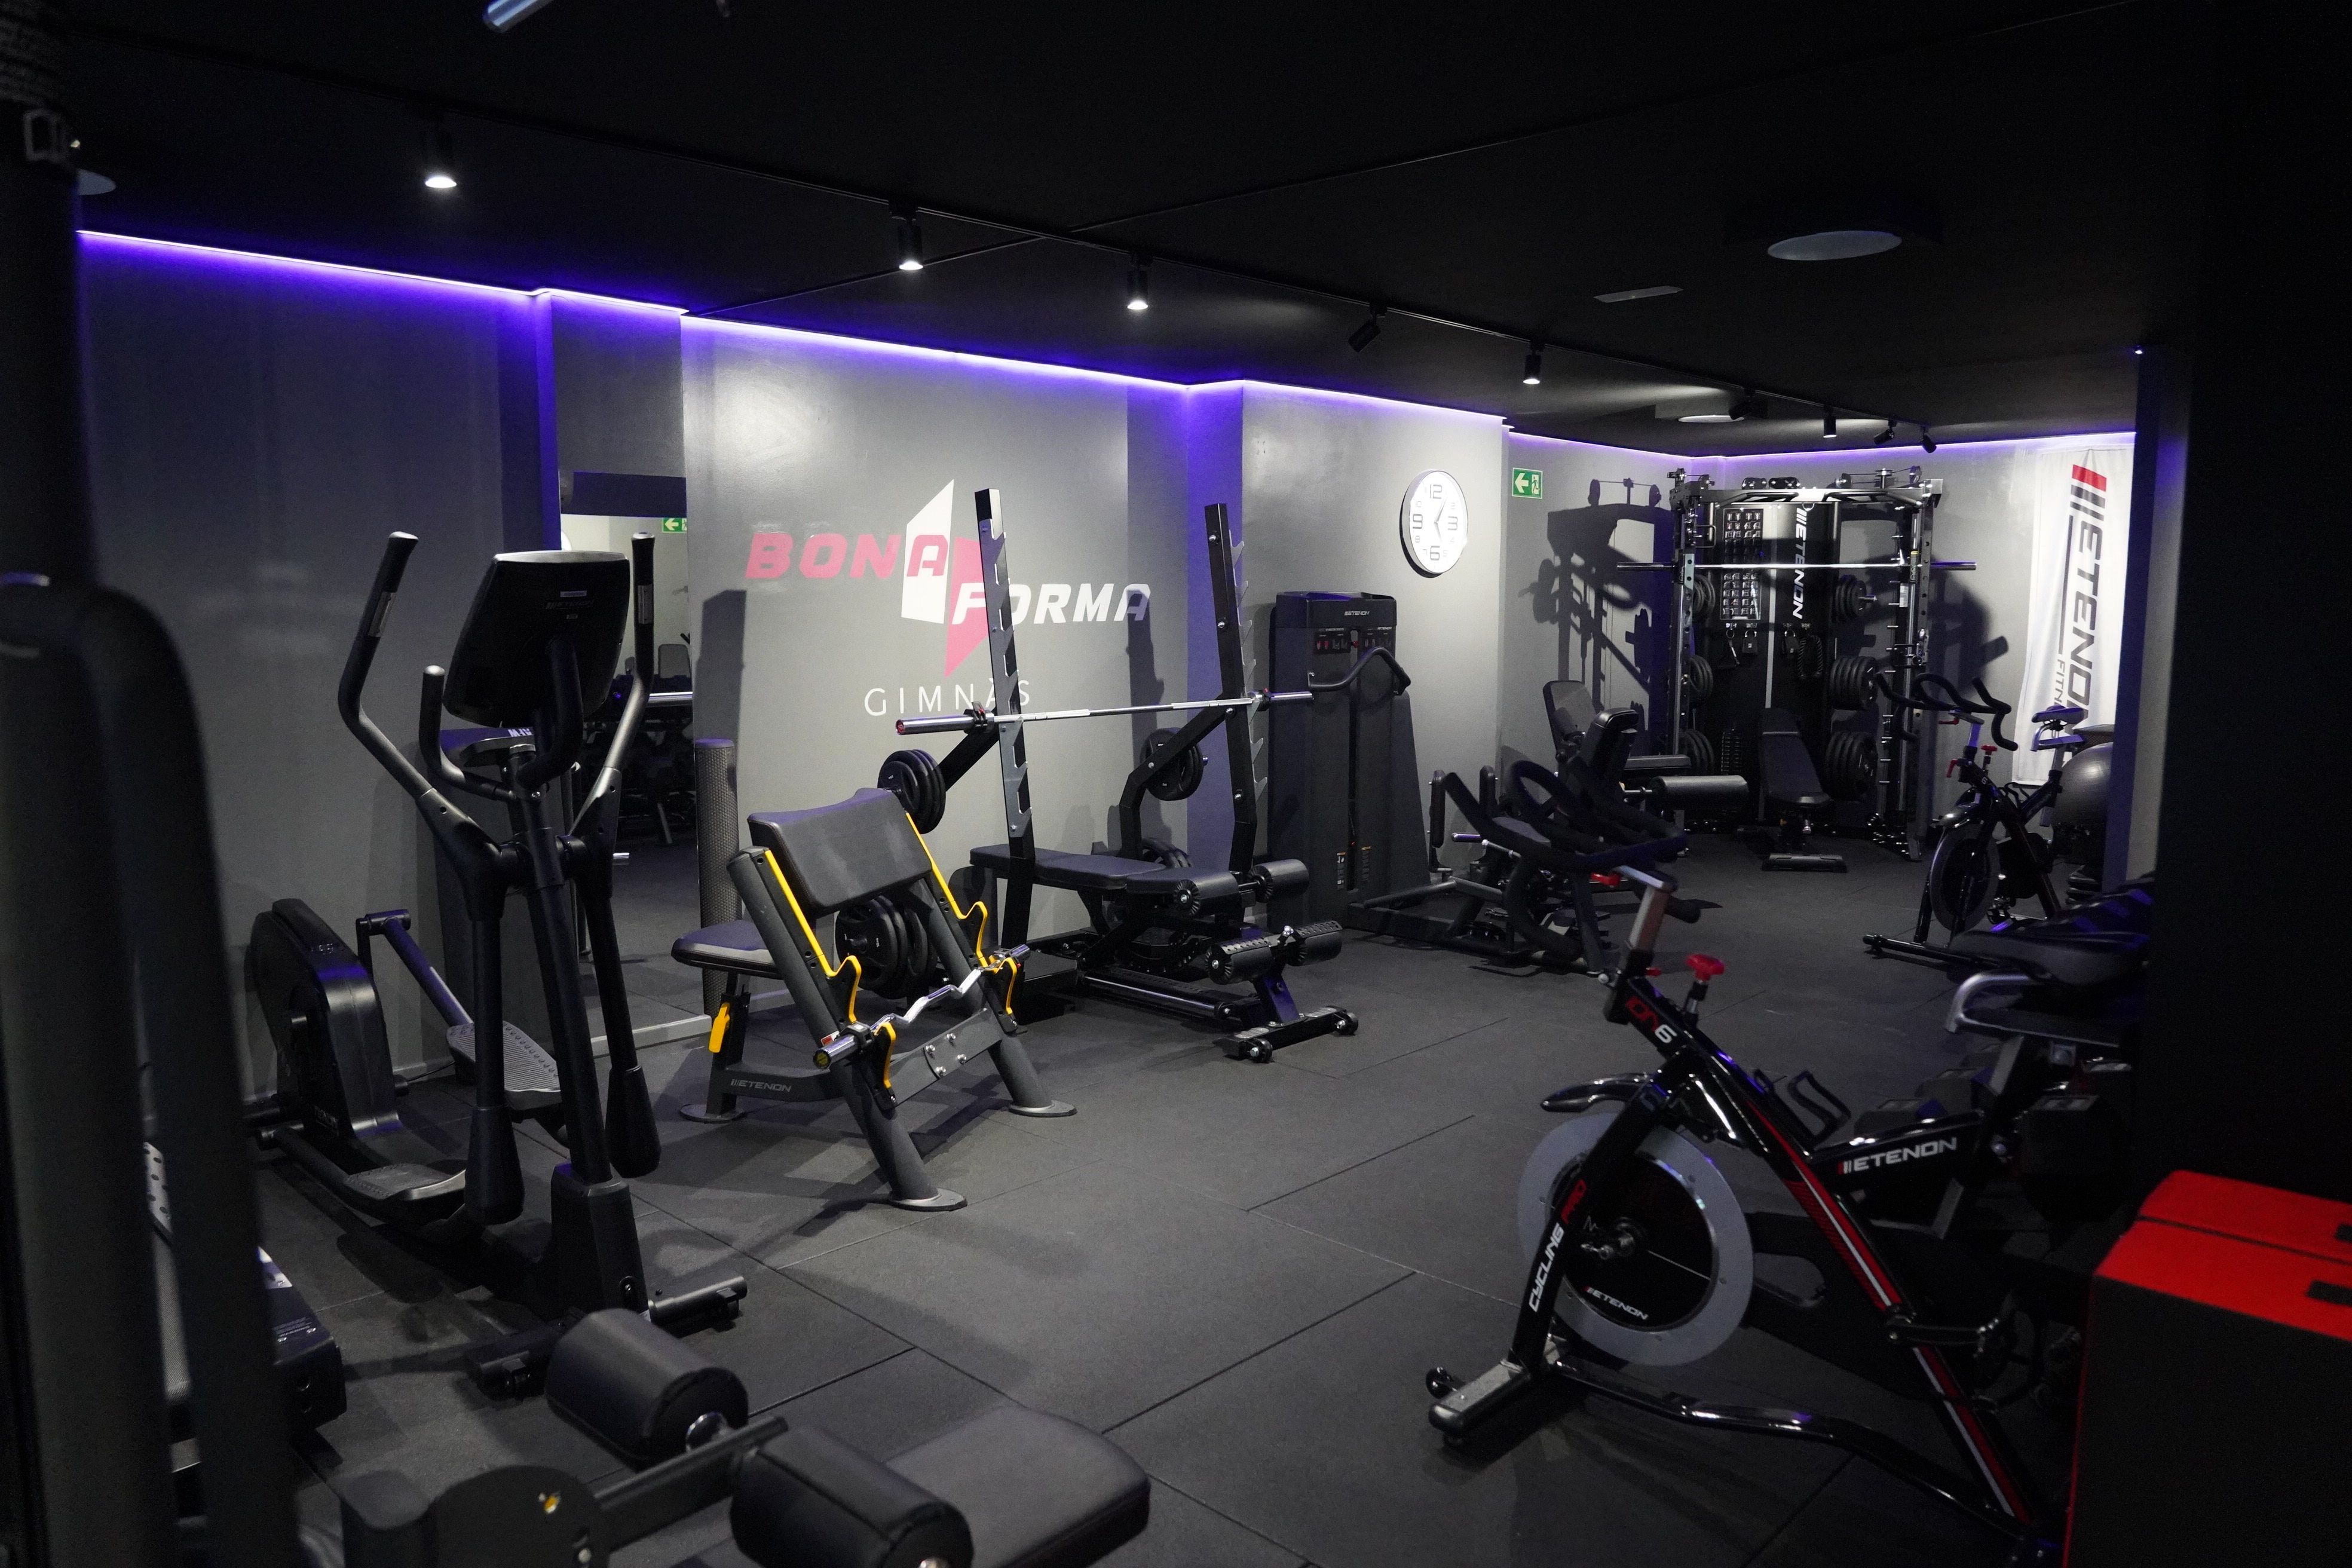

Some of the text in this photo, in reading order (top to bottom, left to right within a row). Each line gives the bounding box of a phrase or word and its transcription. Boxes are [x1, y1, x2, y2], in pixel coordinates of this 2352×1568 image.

[1430, 484, 1443, 499] 12
[1412, 513, 1423, 529] 9
[1448, 516, 1458, 531] 3
[745, 533, 949, 578] BONA
[1430, 545, 1440, 561] 6
[1793, 523, 1806, 620] ETENON
[951, 583, 1151, 625] FORMA
[738, 1079, 792, 1092] ETENON
[1854, 1137, 1958, 1171] ETENON
[1529, 1222, 1564, 1312] CYCLING
[1592, 1289, 1649, 1320] ETENON
